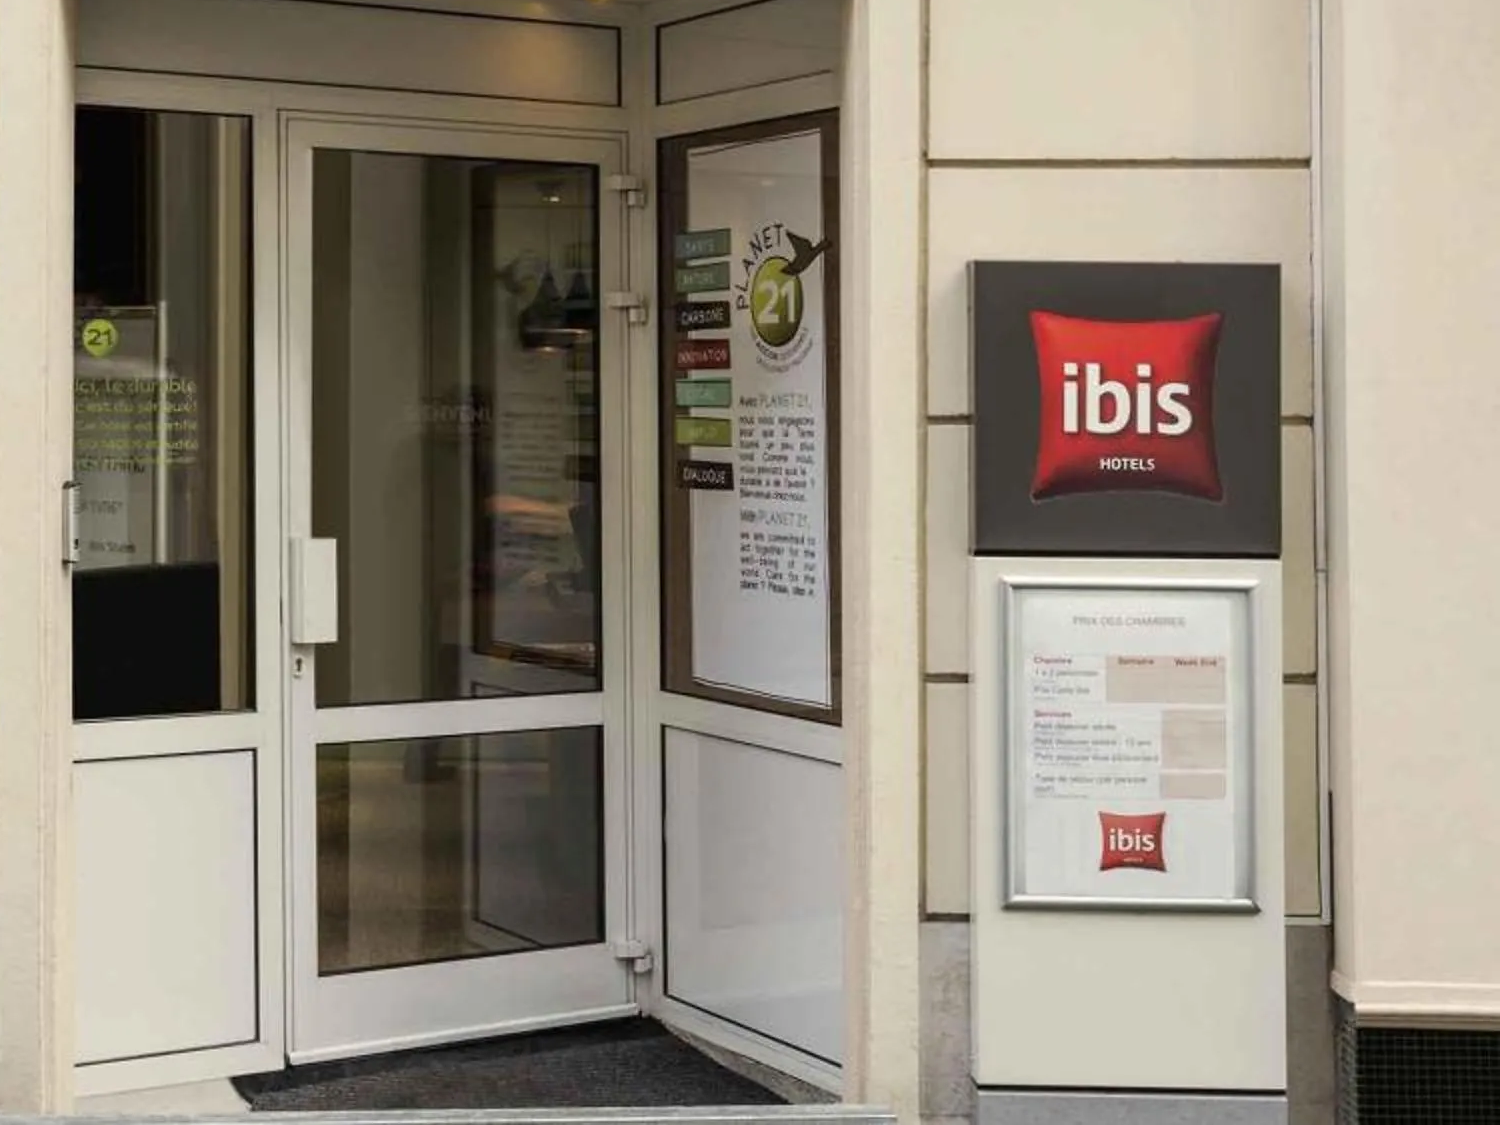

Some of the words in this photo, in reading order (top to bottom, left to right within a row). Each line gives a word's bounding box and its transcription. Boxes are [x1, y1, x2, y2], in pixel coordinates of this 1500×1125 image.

[736, 223, 784, 310] PLANET
[756, 279, 796, 325] 21
[86, 328, 112, 347] 21
[1062, 361, 1194, 437] ibis
[1099, 457, 1156, 472] HOTELS
[1109, 827, 1155, 852] ibis
